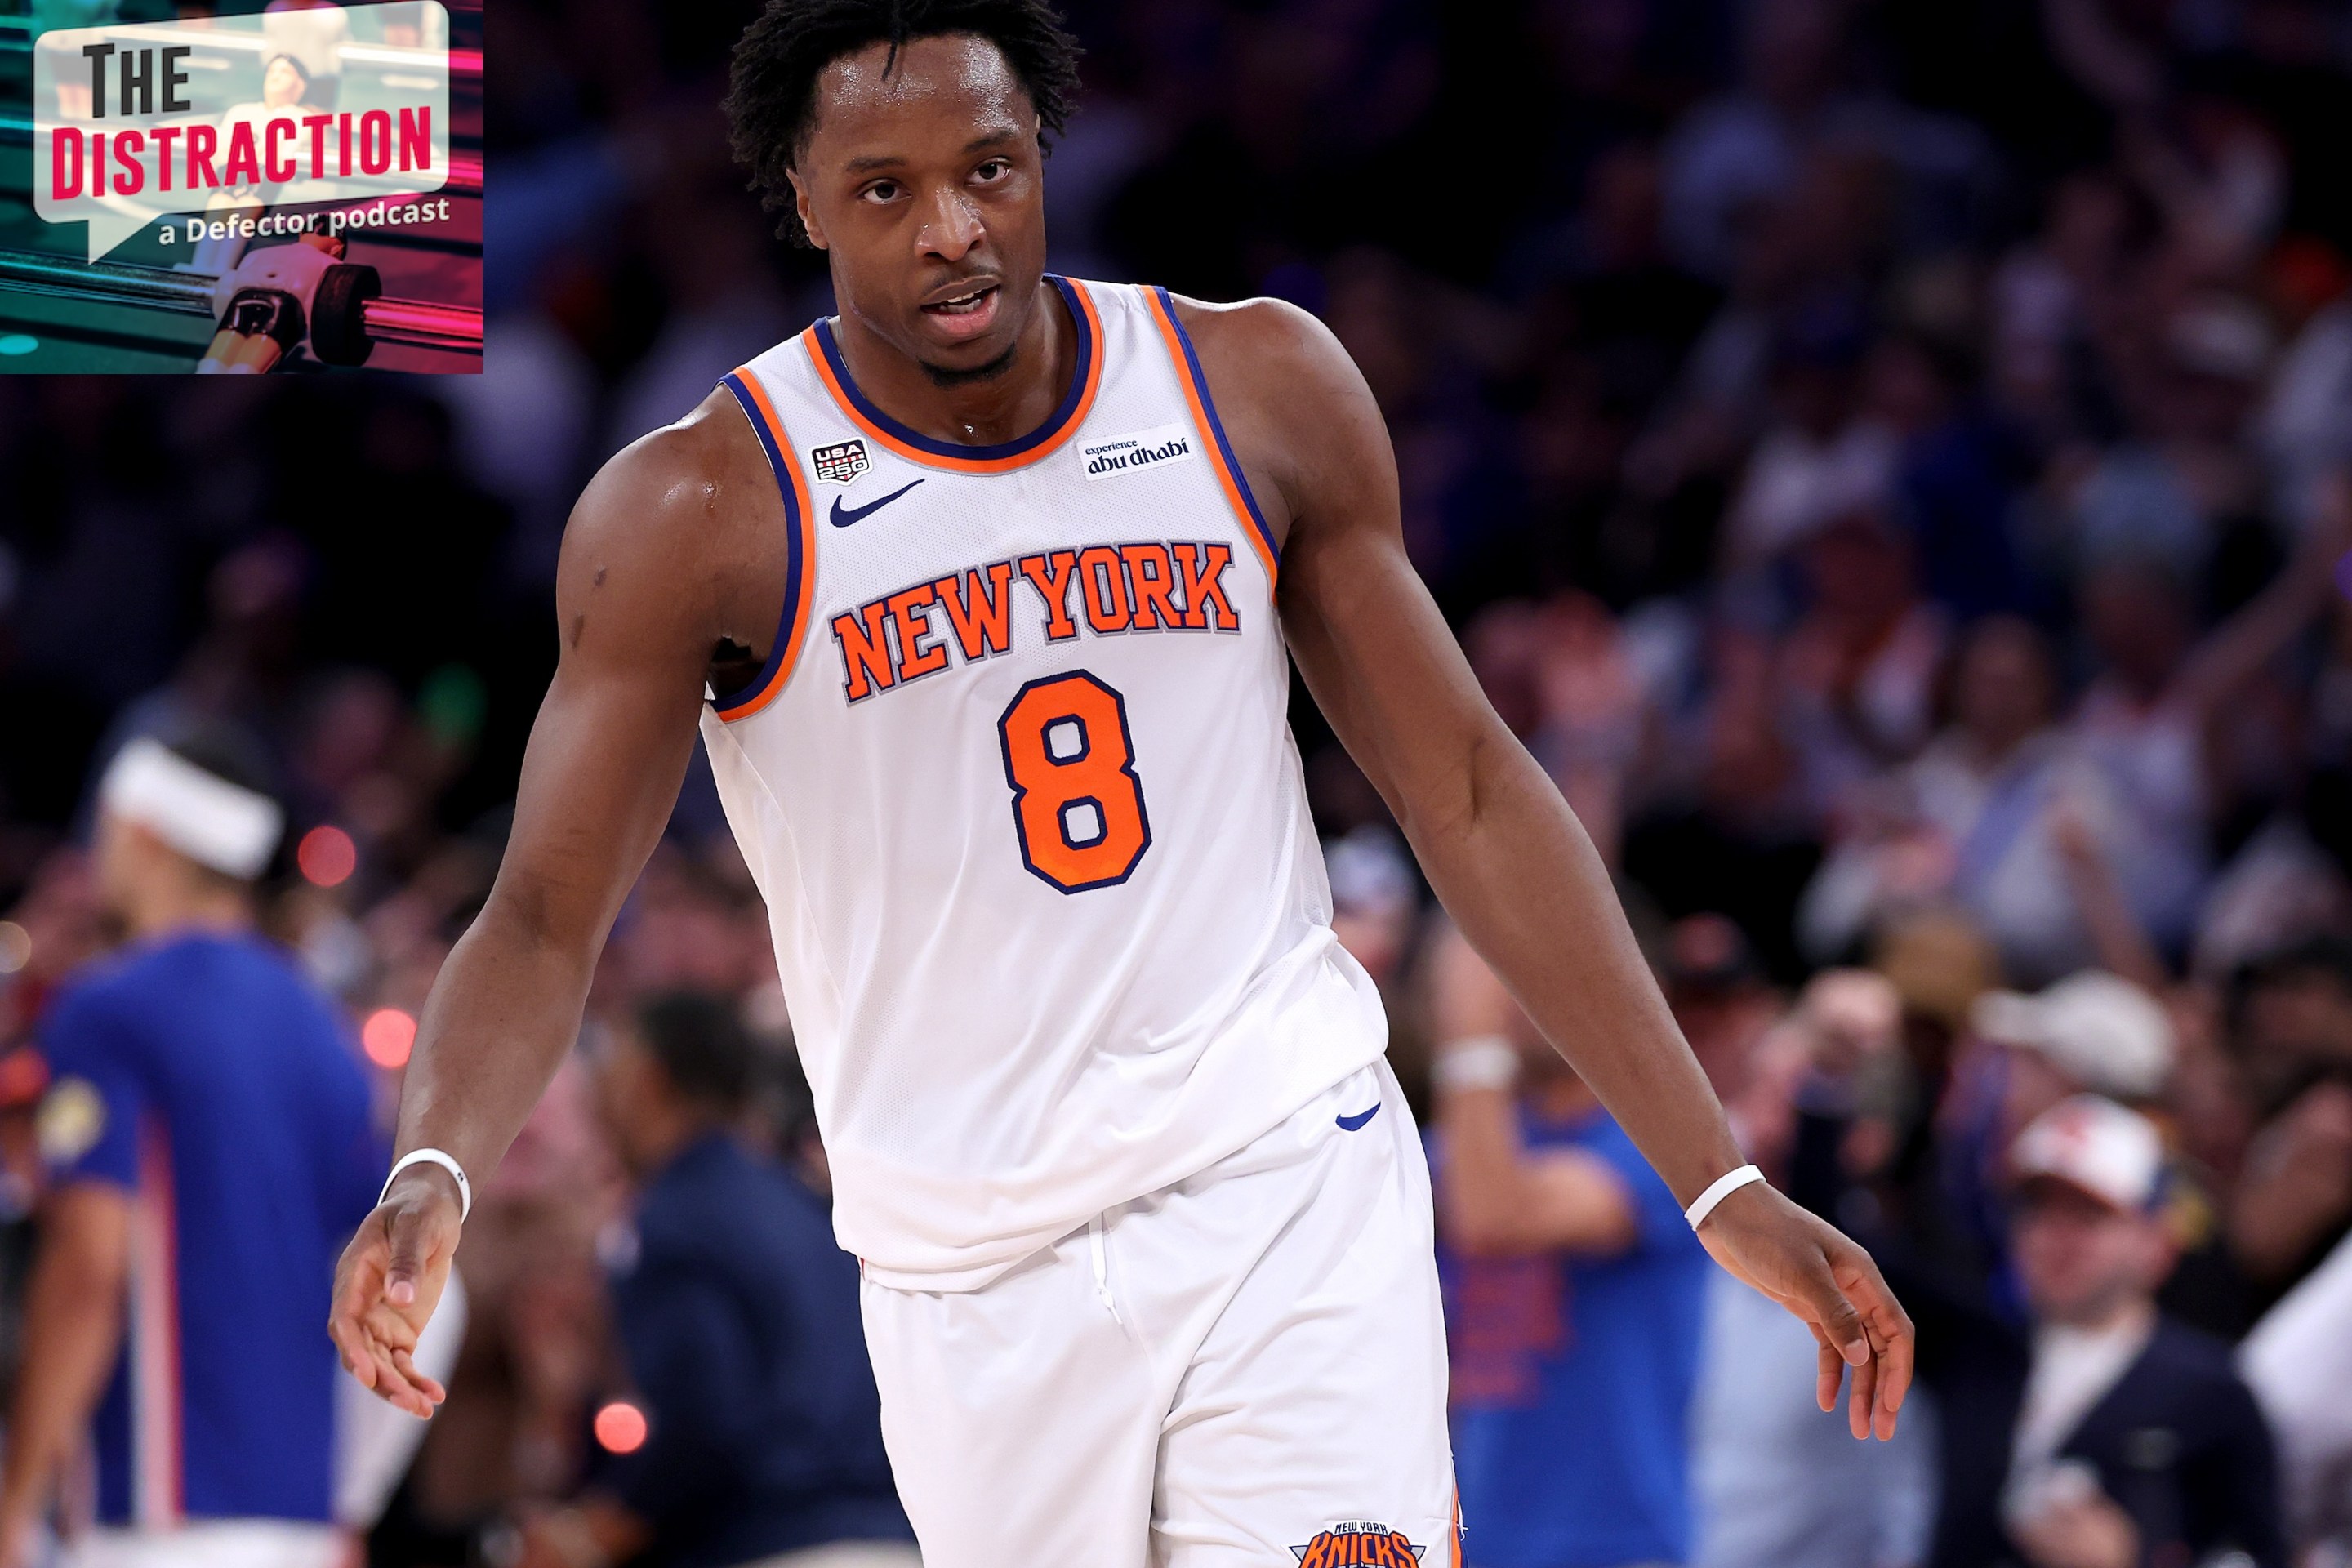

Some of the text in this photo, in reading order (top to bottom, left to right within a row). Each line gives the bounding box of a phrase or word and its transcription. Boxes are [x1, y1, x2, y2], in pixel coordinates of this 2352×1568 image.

[816, 444, 862, 461] USA
[1085, 439, 1138, 455] experience
[818, 459, 868, 479] 250
[1088, 455, 1128, 474] abu
[828, 540, 1241, 706] NEW YORK
[997, 668, 1152, 895] 8
[1334, 1521, 1388, 1535] NEW YORK
[1298, 1530, 1419, 1568] KNICKS
